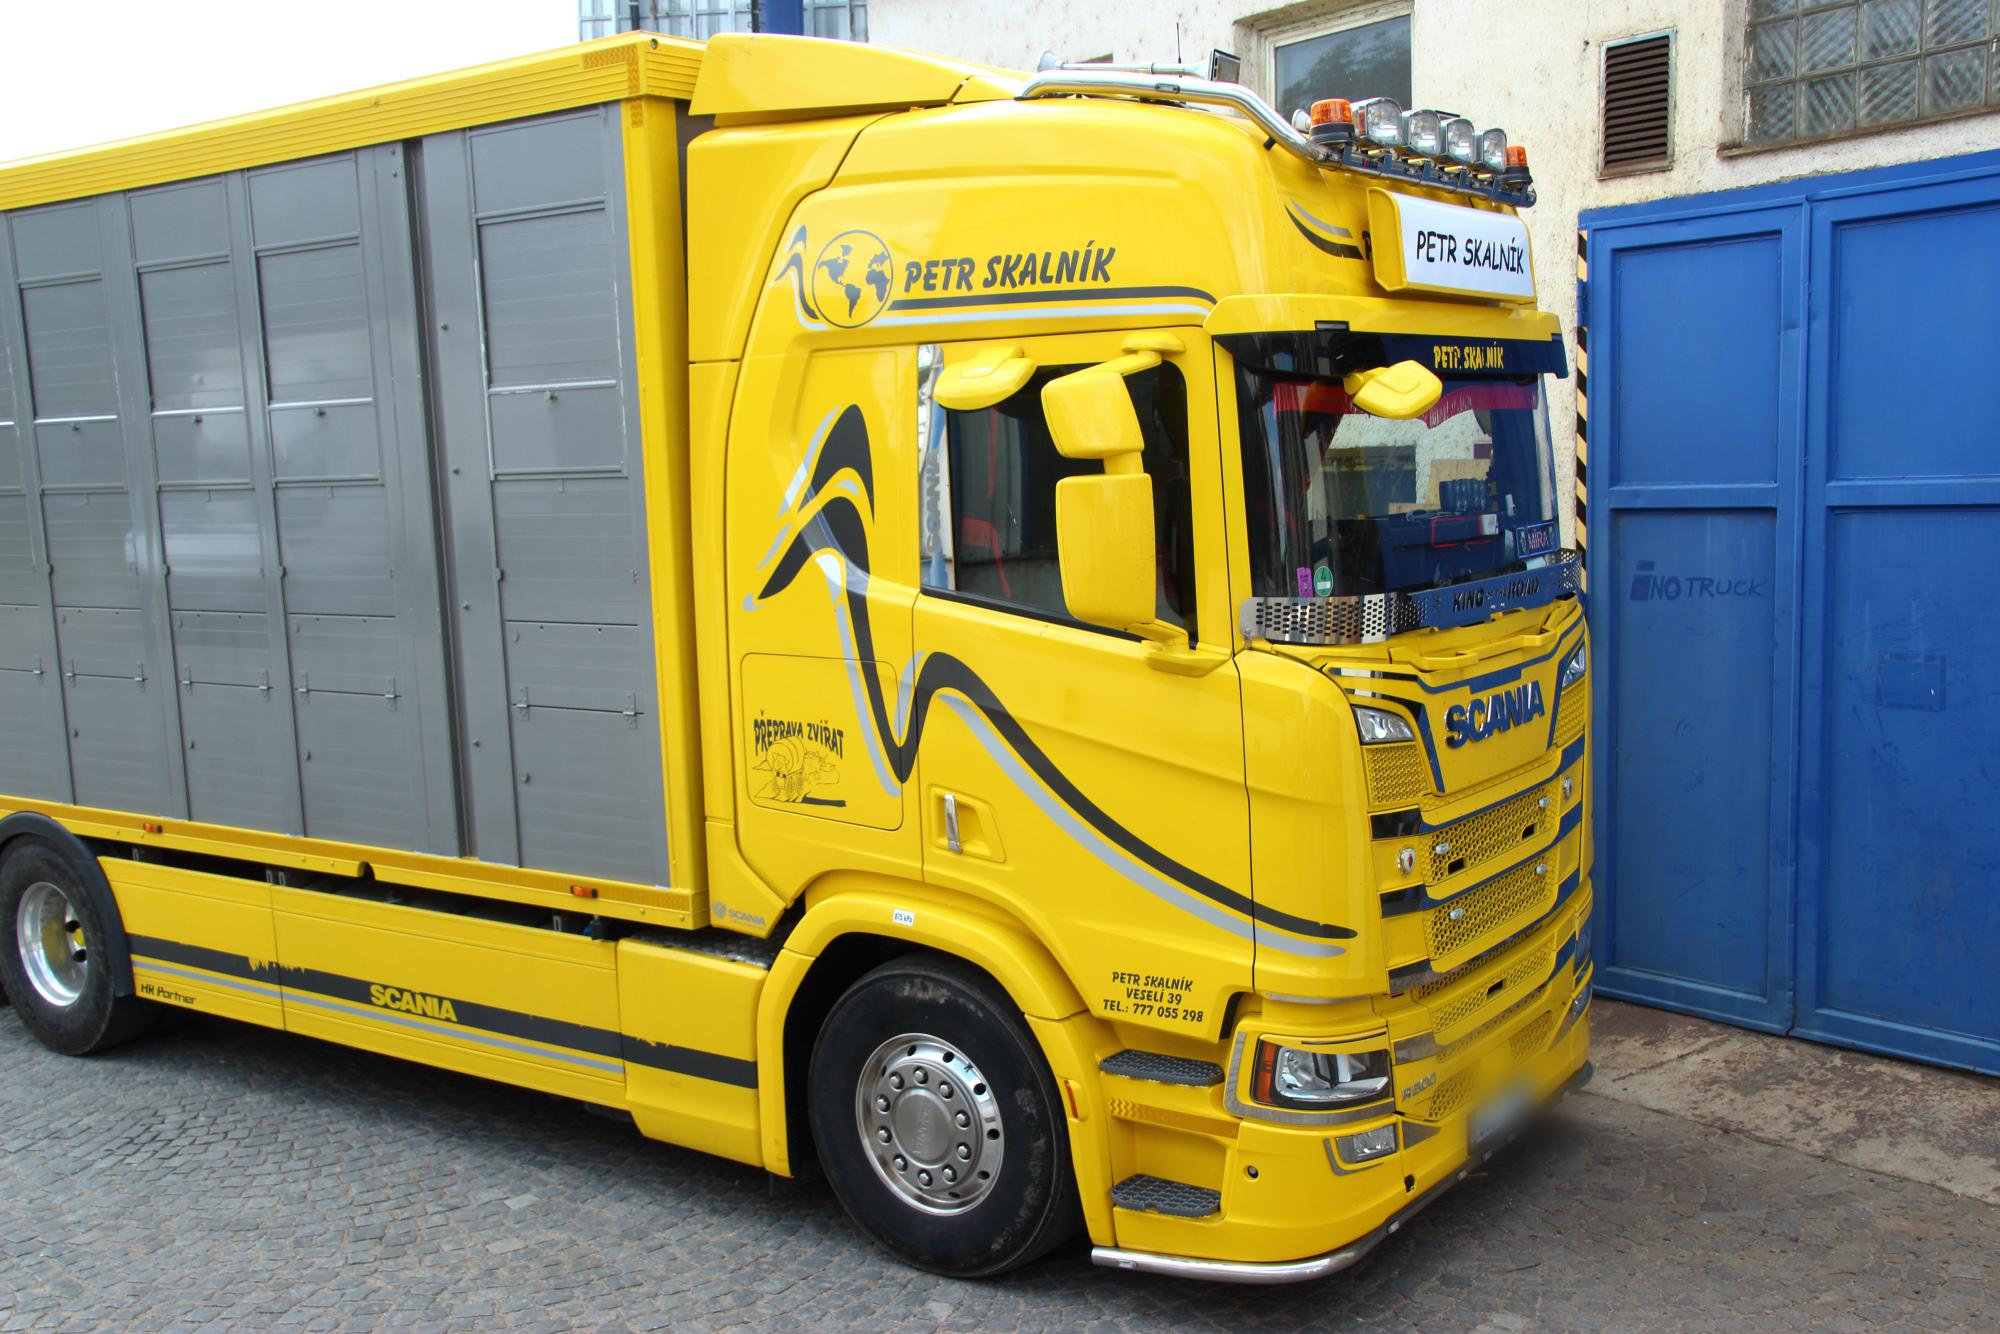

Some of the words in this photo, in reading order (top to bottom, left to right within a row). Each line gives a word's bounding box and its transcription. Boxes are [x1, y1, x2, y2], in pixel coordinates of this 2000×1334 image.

[1416, 230, 1457, 263] PETR
[1463, 237, 1524, 274] SKALNÍK
[904, 256, 975, 293] PETR
[983, 240, 1116, 289] SKALNÍK
[1320, 567, 1326, 580] 4
[1453, 587, 1484, 612] KING
[1444, 680, 1545, 749] SCANIA
[753, 708, 804, 757] PŘEPRAVA
[806, 719, 844, 760] ZVÍŘAT
[1112, 971, 1140, 986] PETR
[1144, 976, 1193, 992] SKALNÍK
[157, 985, 196, 1005] Partner
[369, 984, 458, 1022] SCANIA
[1126, 988, 1165, 1003] VESELÍ
[1167, 993, 1182, 1005] 39
[1103, 999, 1129, 1013] TEL.:
[1133, 1003, 1153, 1016] 777
[1157, 1006, 1178, 1019] 055
[1182, 1009, 1204, 1022] 298
